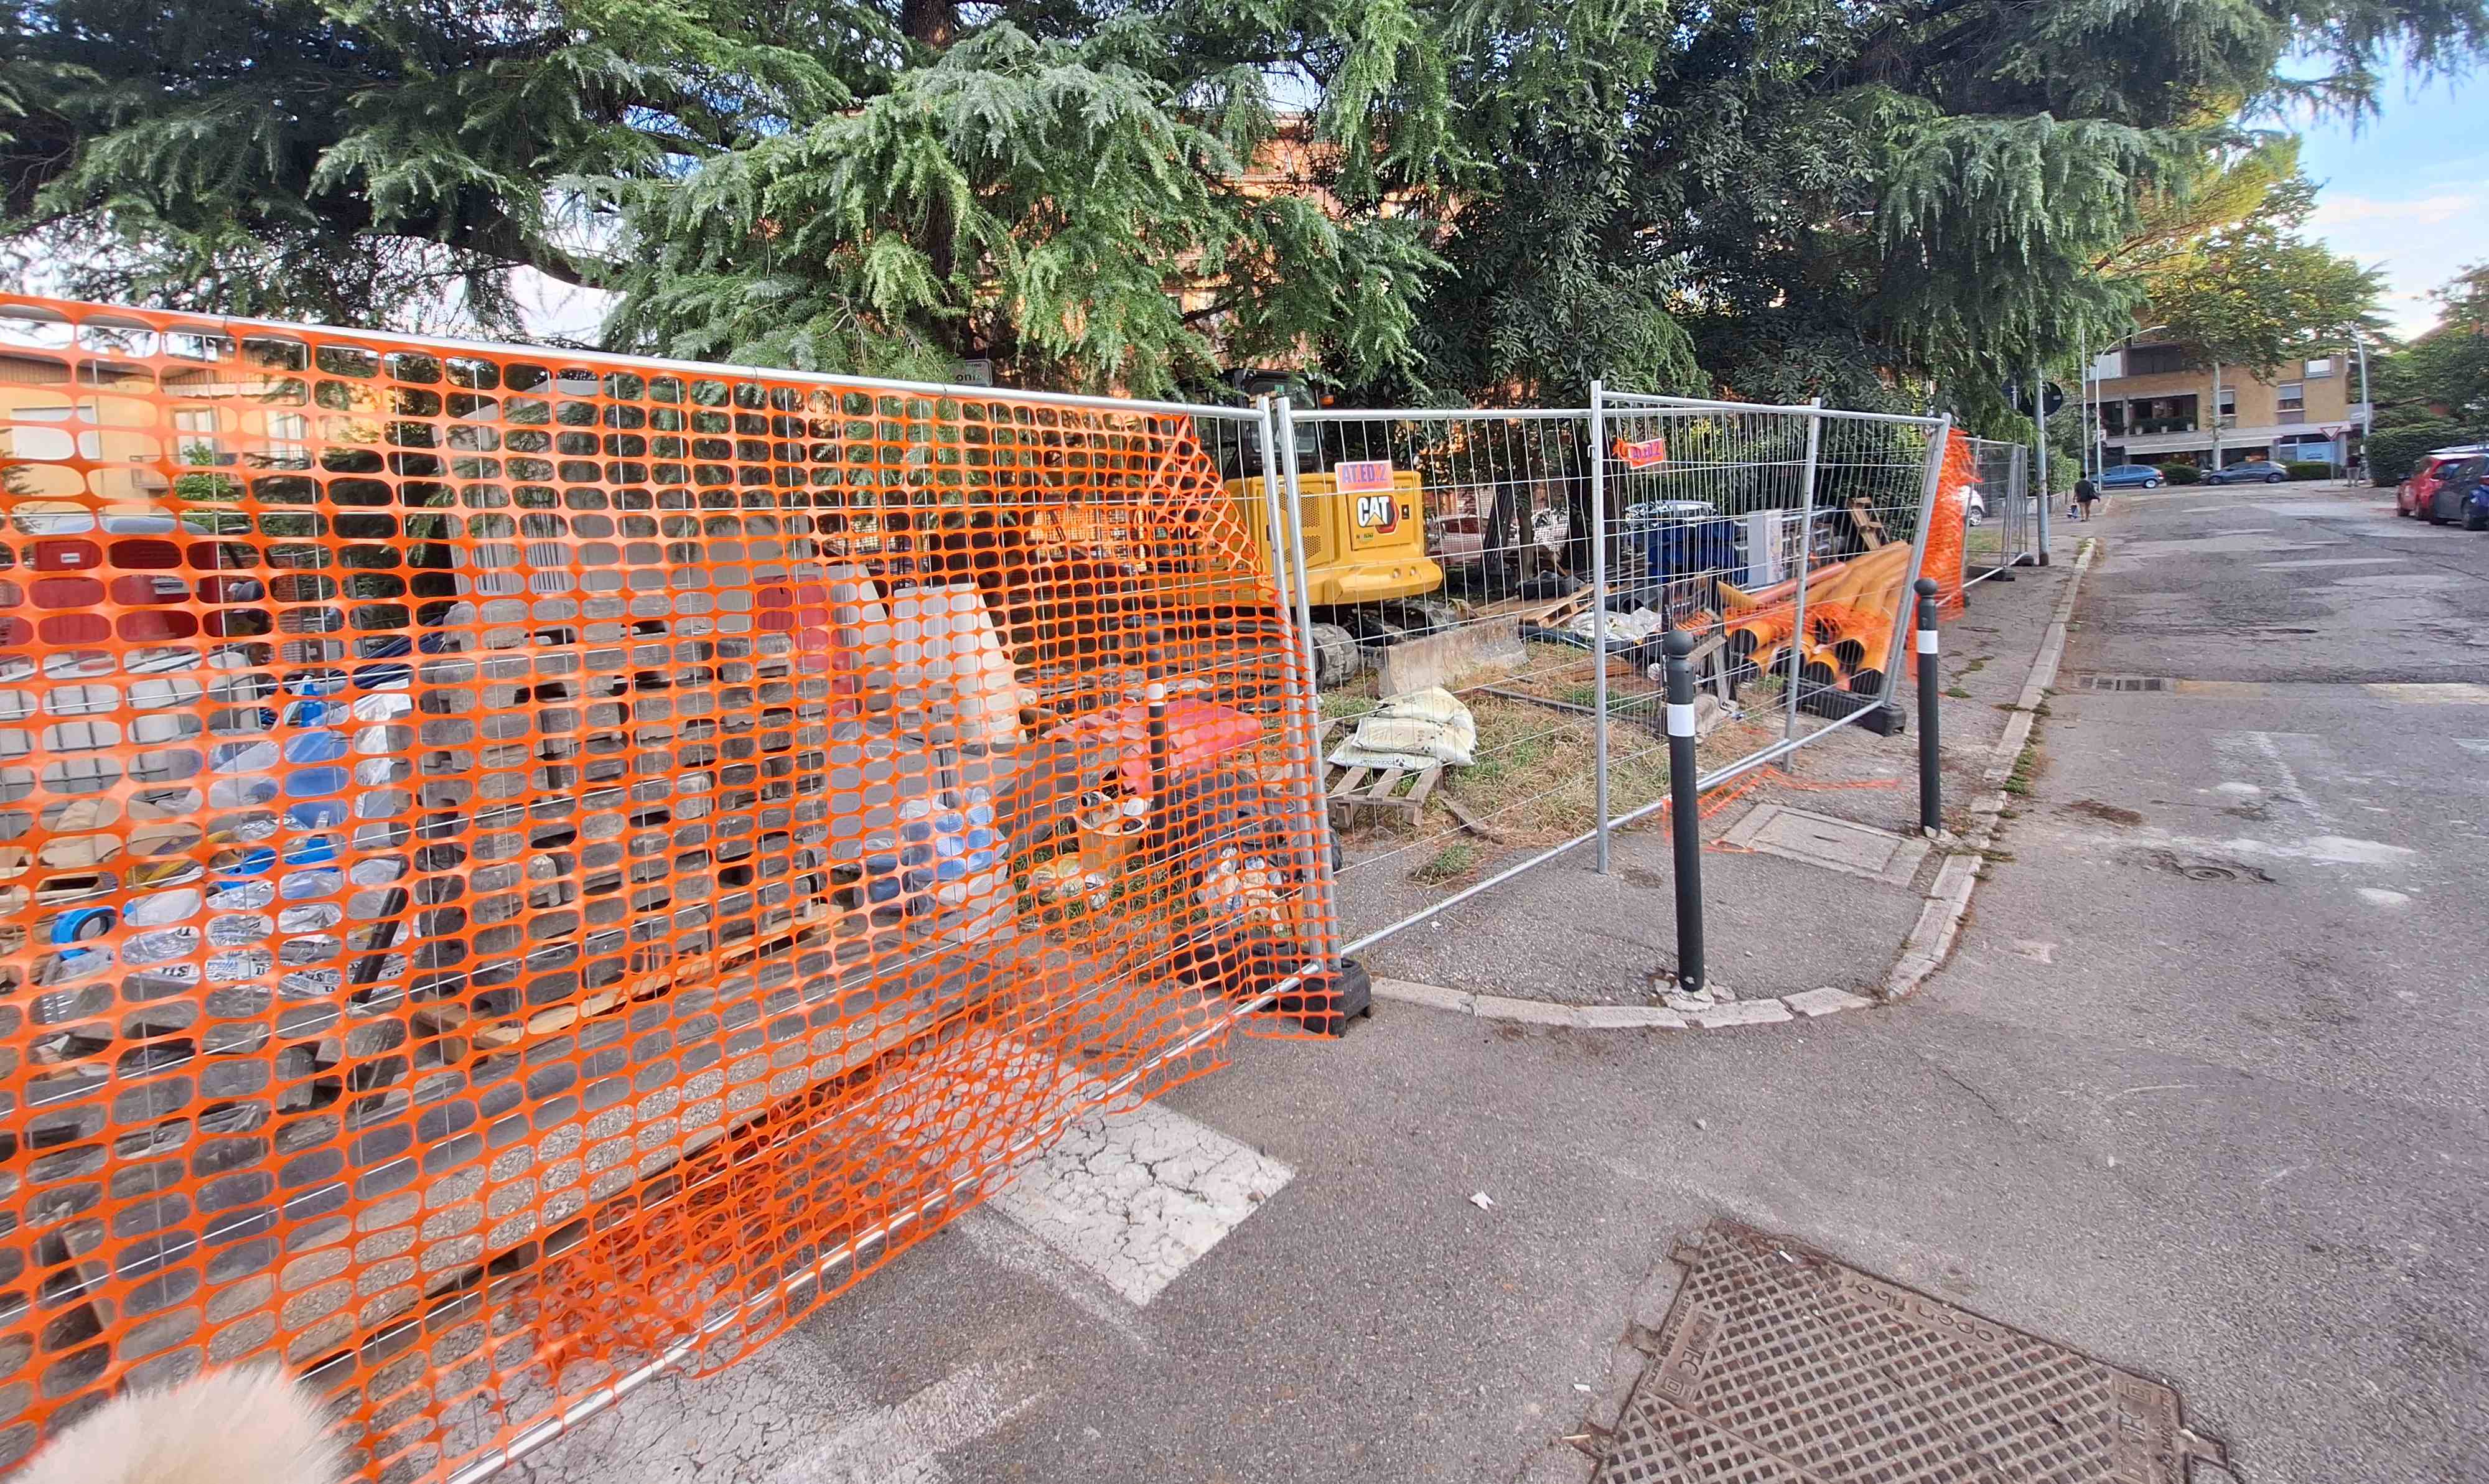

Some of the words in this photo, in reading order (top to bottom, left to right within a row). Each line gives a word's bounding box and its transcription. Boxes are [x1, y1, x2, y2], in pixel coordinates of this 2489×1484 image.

[1357, 496, 1389, 528] CAT
[1847, 1279, 1906, 1312] fiber
[1917, 1303, 1994, 1342] open
